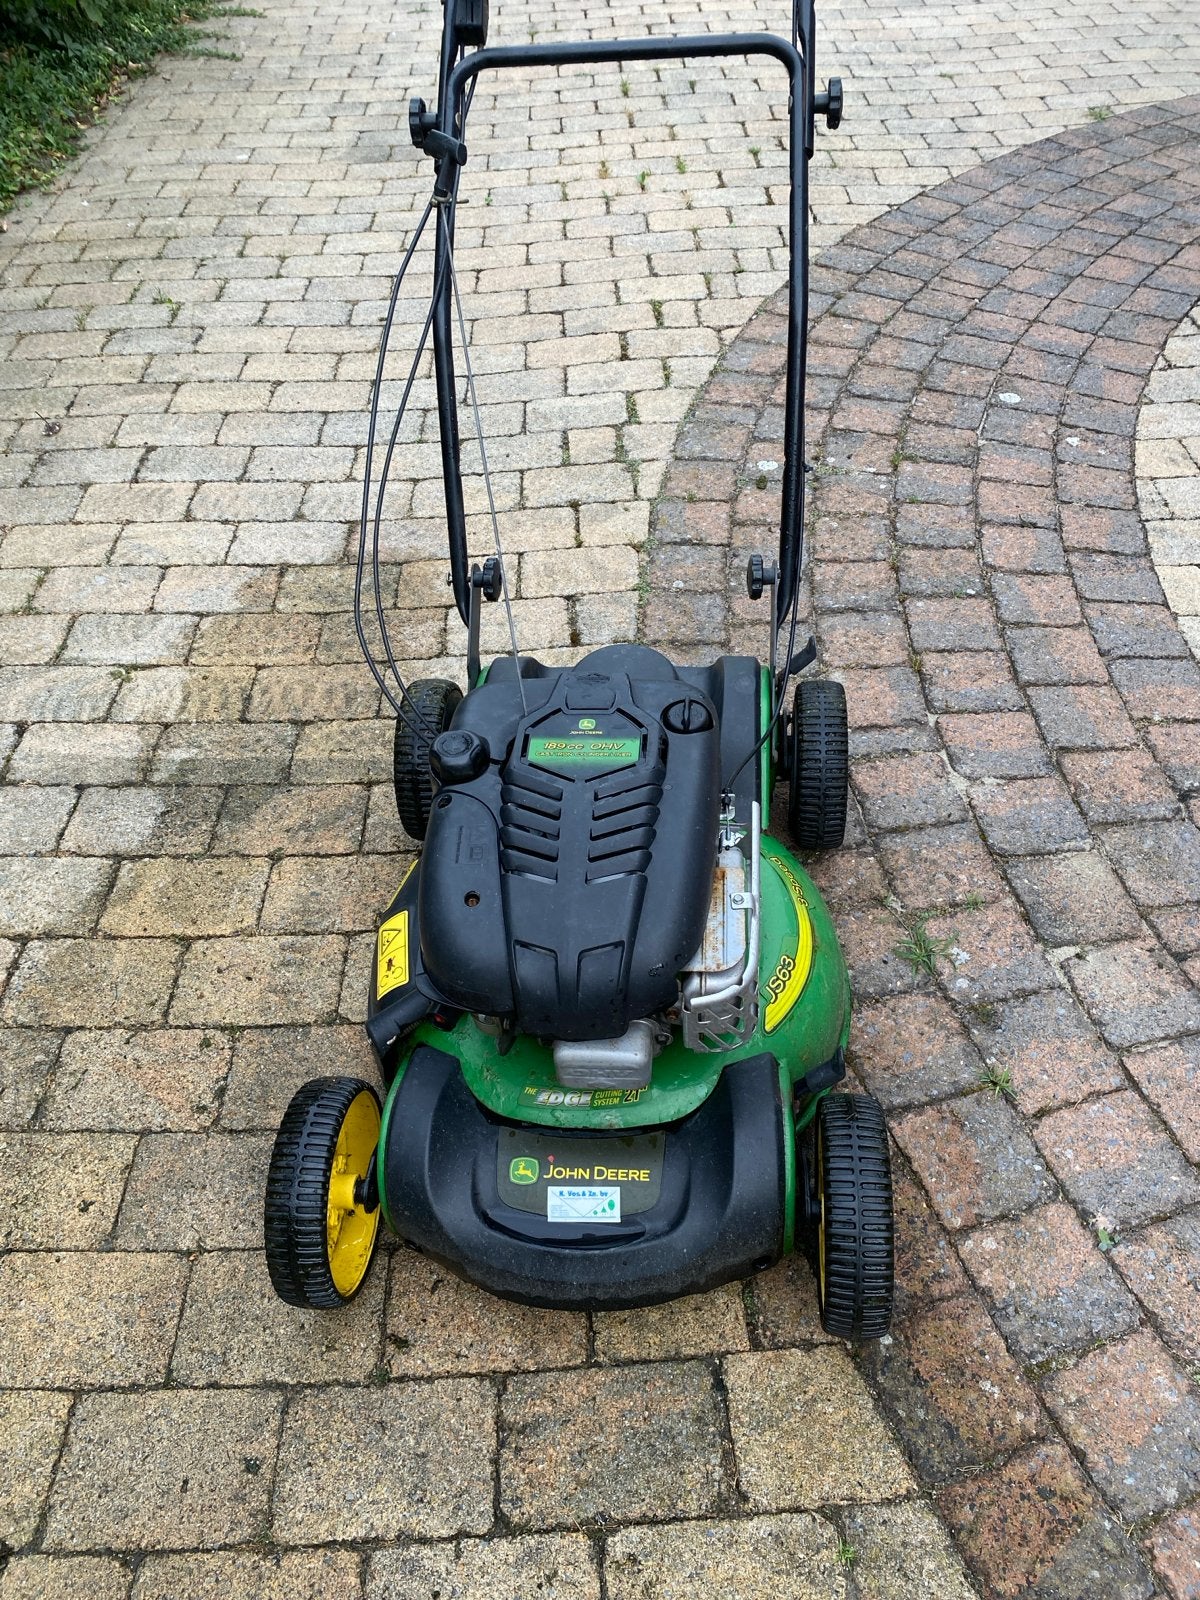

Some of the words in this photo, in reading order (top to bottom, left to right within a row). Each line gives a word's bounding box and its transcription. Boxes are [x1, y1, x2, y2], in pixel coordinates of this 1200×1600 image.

[590, 742, 625, 750] OHV
[766, 955, 796, 1004] JS63
[524, 1086, 538, 1096] THE
[534, 1088, 595, 1107] EDGE
[595, 1089, 623, 1099] CUTTING
[593, 1097, 620, 1107] SYSTEM
[543, 1164, 590, 1180] JOHN
[594, 1166, 650, 1182] DEERE
